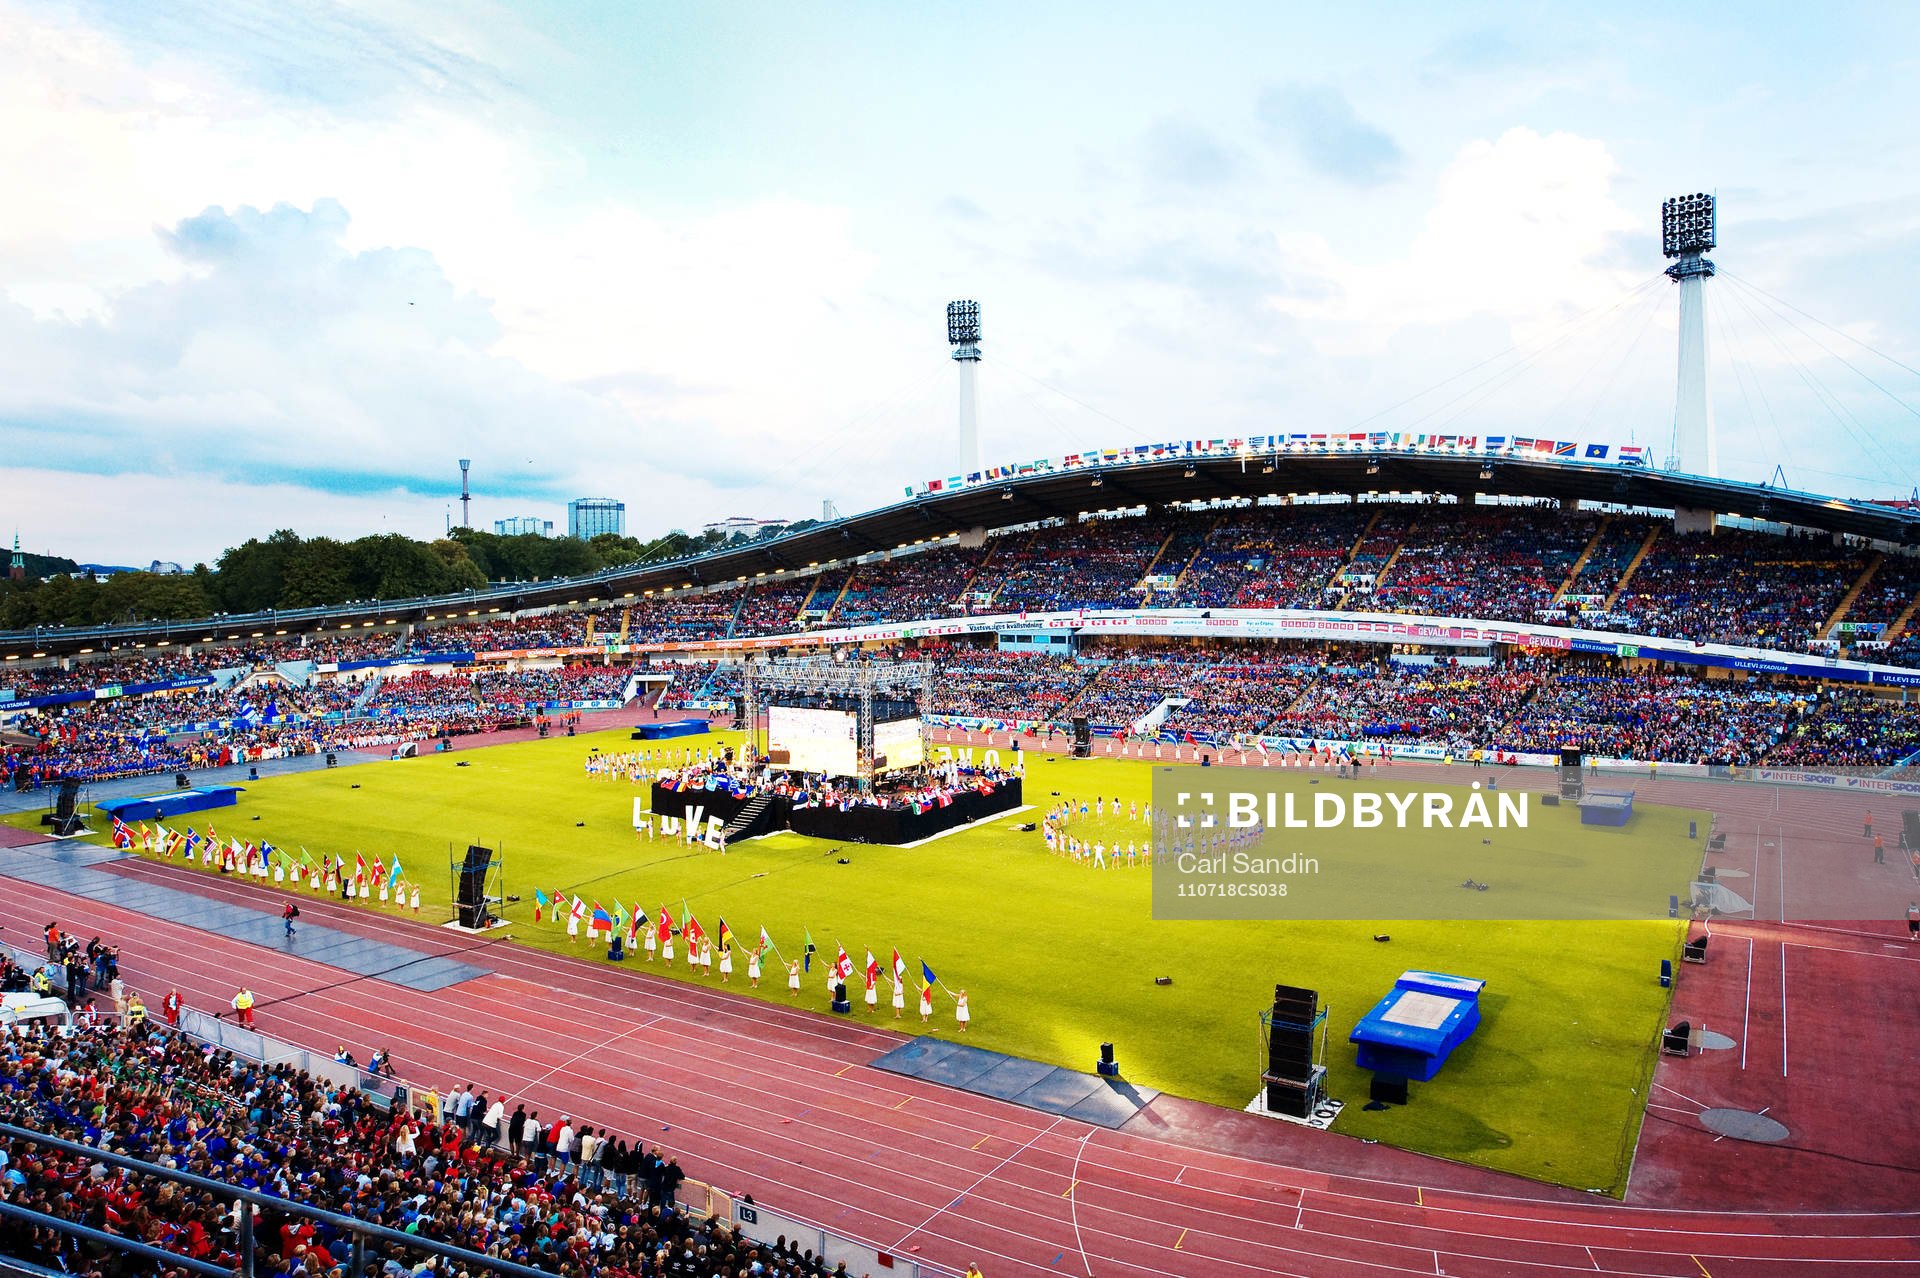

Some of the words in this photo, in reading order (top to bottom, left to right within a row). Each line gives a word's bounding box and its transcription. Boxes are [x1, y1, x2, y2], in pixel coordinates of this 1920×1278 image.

[1418, 627, 1450, 638] GEVALIA
[1529, 637, 1564, 648] GEVALIA
[1571, 642, 1592, 650] ULLEVI
[1734, 661, 1758, 669] ULLEVI
[1758, 663, 1788, 671] STADIUM
[171, 679, 188, 687] ULLEVI
[1883, 675, 1909, 683] ULLEVI
[7, 700, 30, 708] STADIUM
[1772, 772, 1836, 785] INTERSPORT
[742, 1208, 753, 1221] L3
